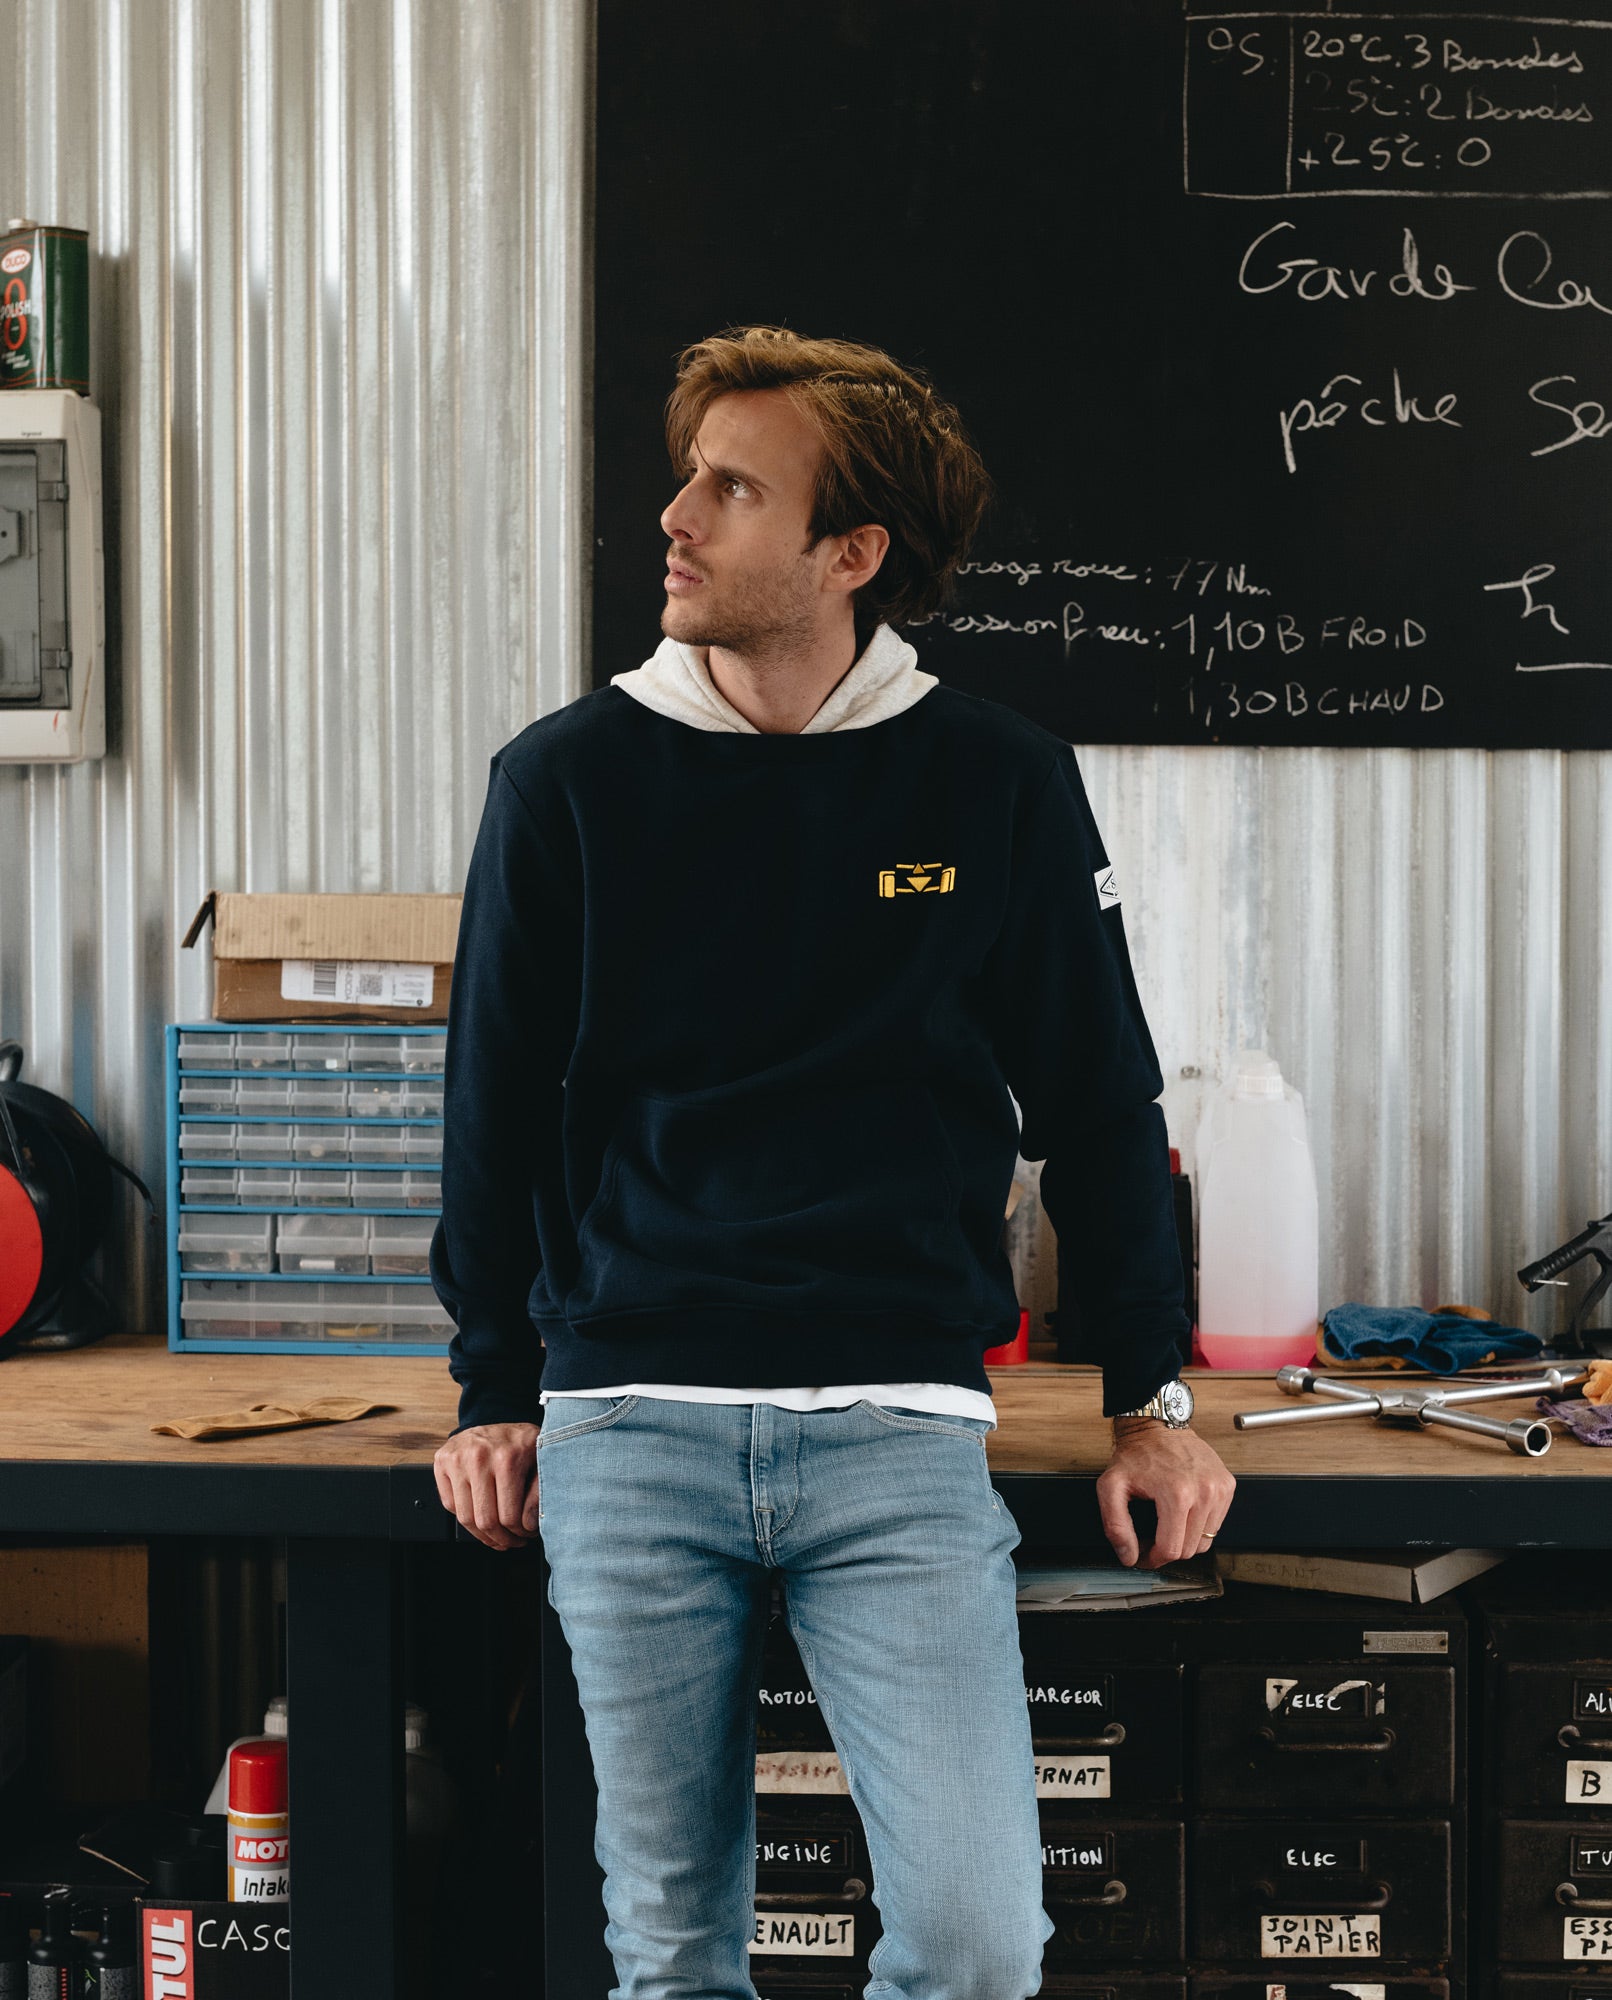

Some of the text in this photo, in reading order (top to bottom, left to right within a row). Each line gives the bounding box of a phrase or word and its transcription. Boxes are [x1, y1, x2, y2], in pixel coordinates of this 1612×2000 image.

[1238, 221, 1477, 301] Garde
[1321, 616, 1427, 650] FROID
[1317, 684, 1445, 715] CHAUD
[1291, 1693, 1342, 1710] ELEC
[1580, 1769, 1601, 1797] B
[1267, 1915, 1356, 1933] JOINT
[1273, 1931, 1379, 1955] PAPIER
